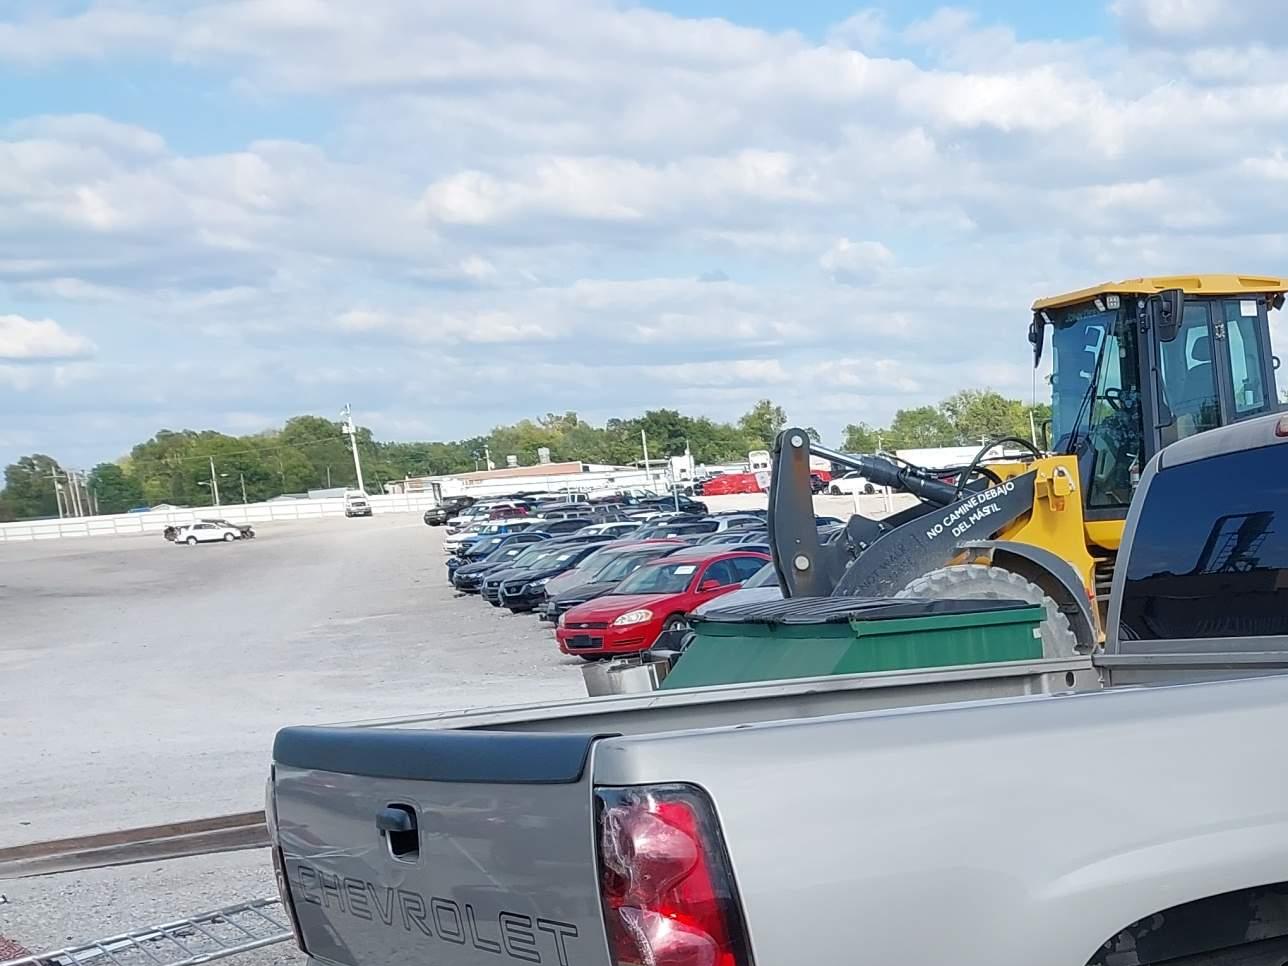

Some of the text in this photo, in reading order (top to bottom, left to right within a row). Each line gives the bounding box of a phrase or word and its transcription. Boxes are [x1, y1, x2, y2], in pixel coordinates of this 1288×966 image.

[926, 481, 1015, 540] NO CAMINE DEBAJO
[951, 503, 1001, 537] DEL MÁSTIL
